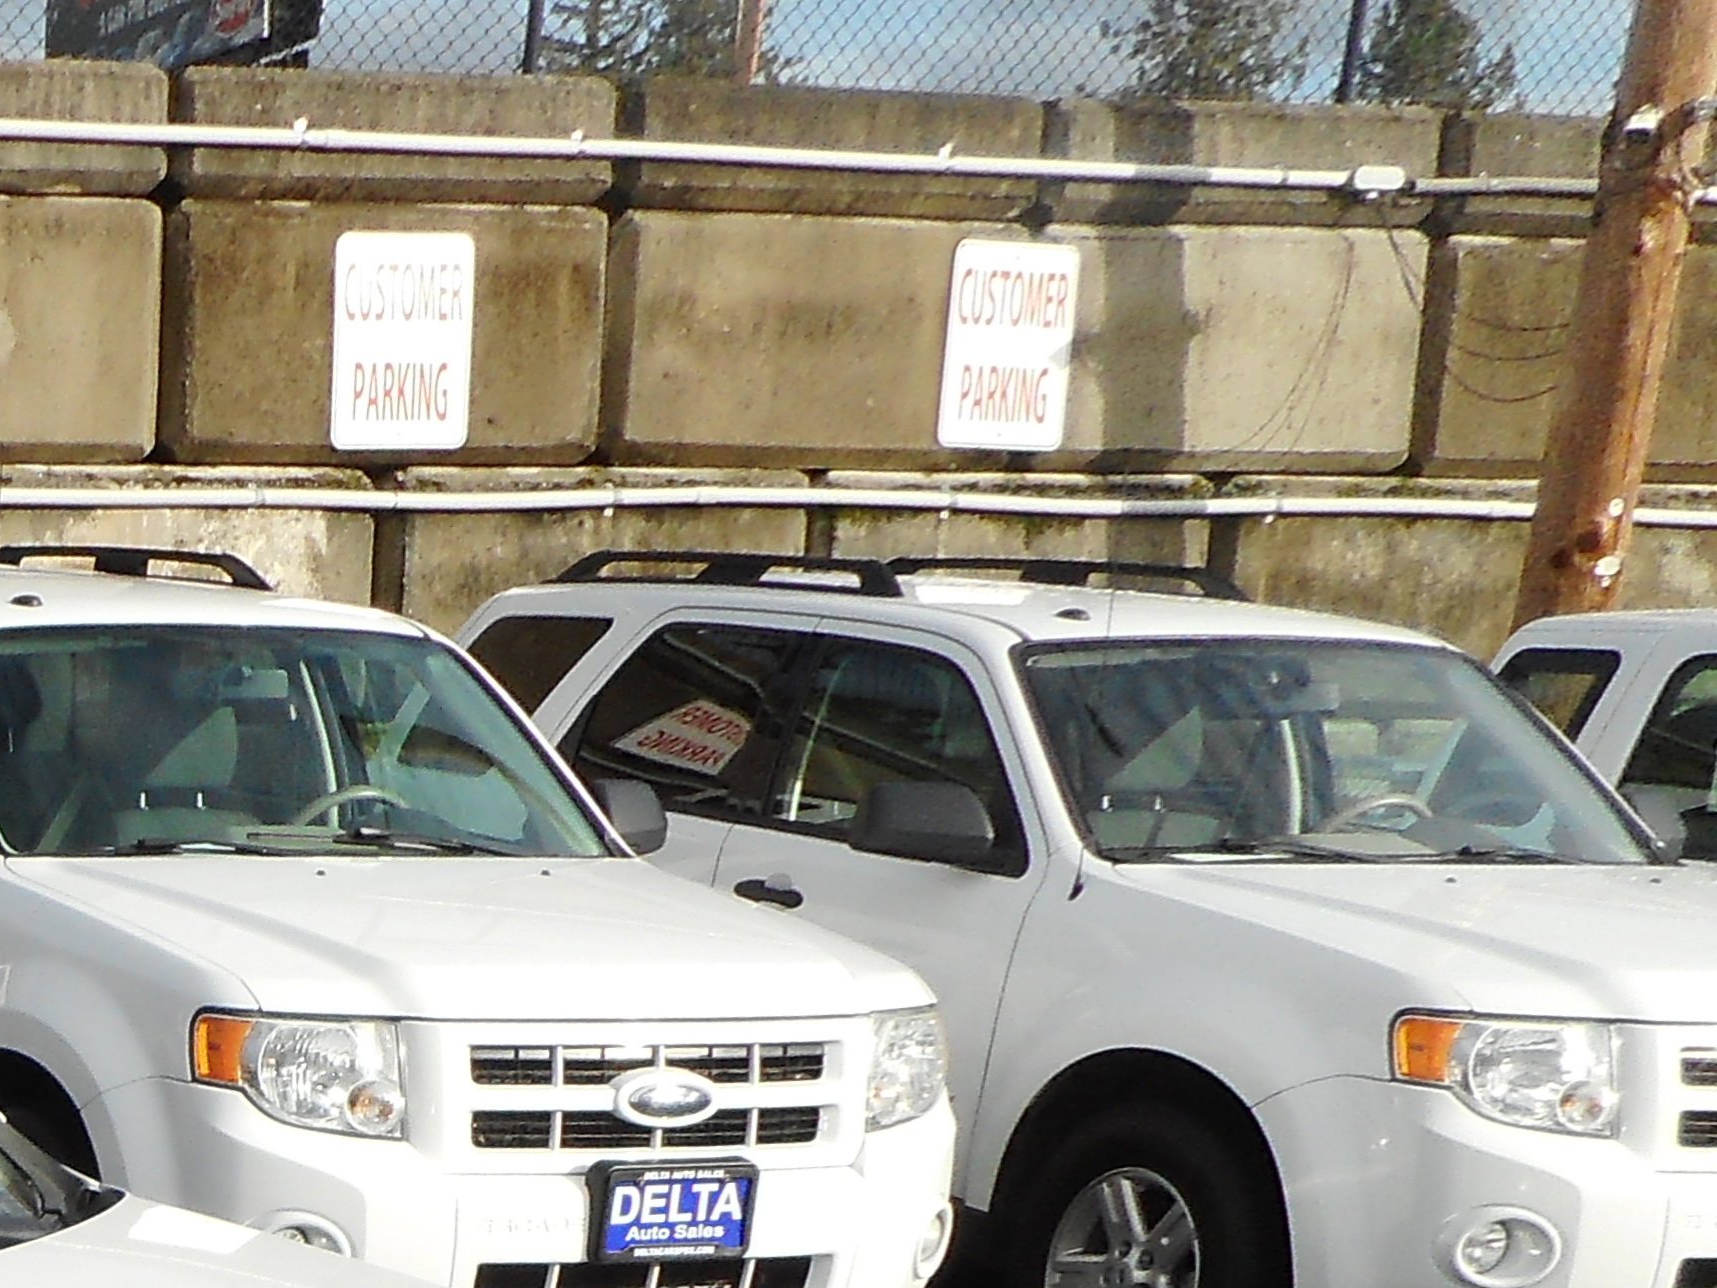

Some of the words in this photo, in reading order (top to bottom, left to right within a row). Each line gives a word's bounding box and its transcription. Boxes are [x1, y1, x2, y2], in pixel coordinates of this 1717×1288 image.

[344, 263, 463, 322] CUSTOMER
[957, 267, 1068, 329] CUSTOMER
[352, 362, 448, 422] PARKING
[959, 364, 1049, 425] PARKING
[610, 1181, 743, 1225] DELTA
[625, 1225, 670, 1241] Auto
[673, 1223, 725, 1239] Sales
